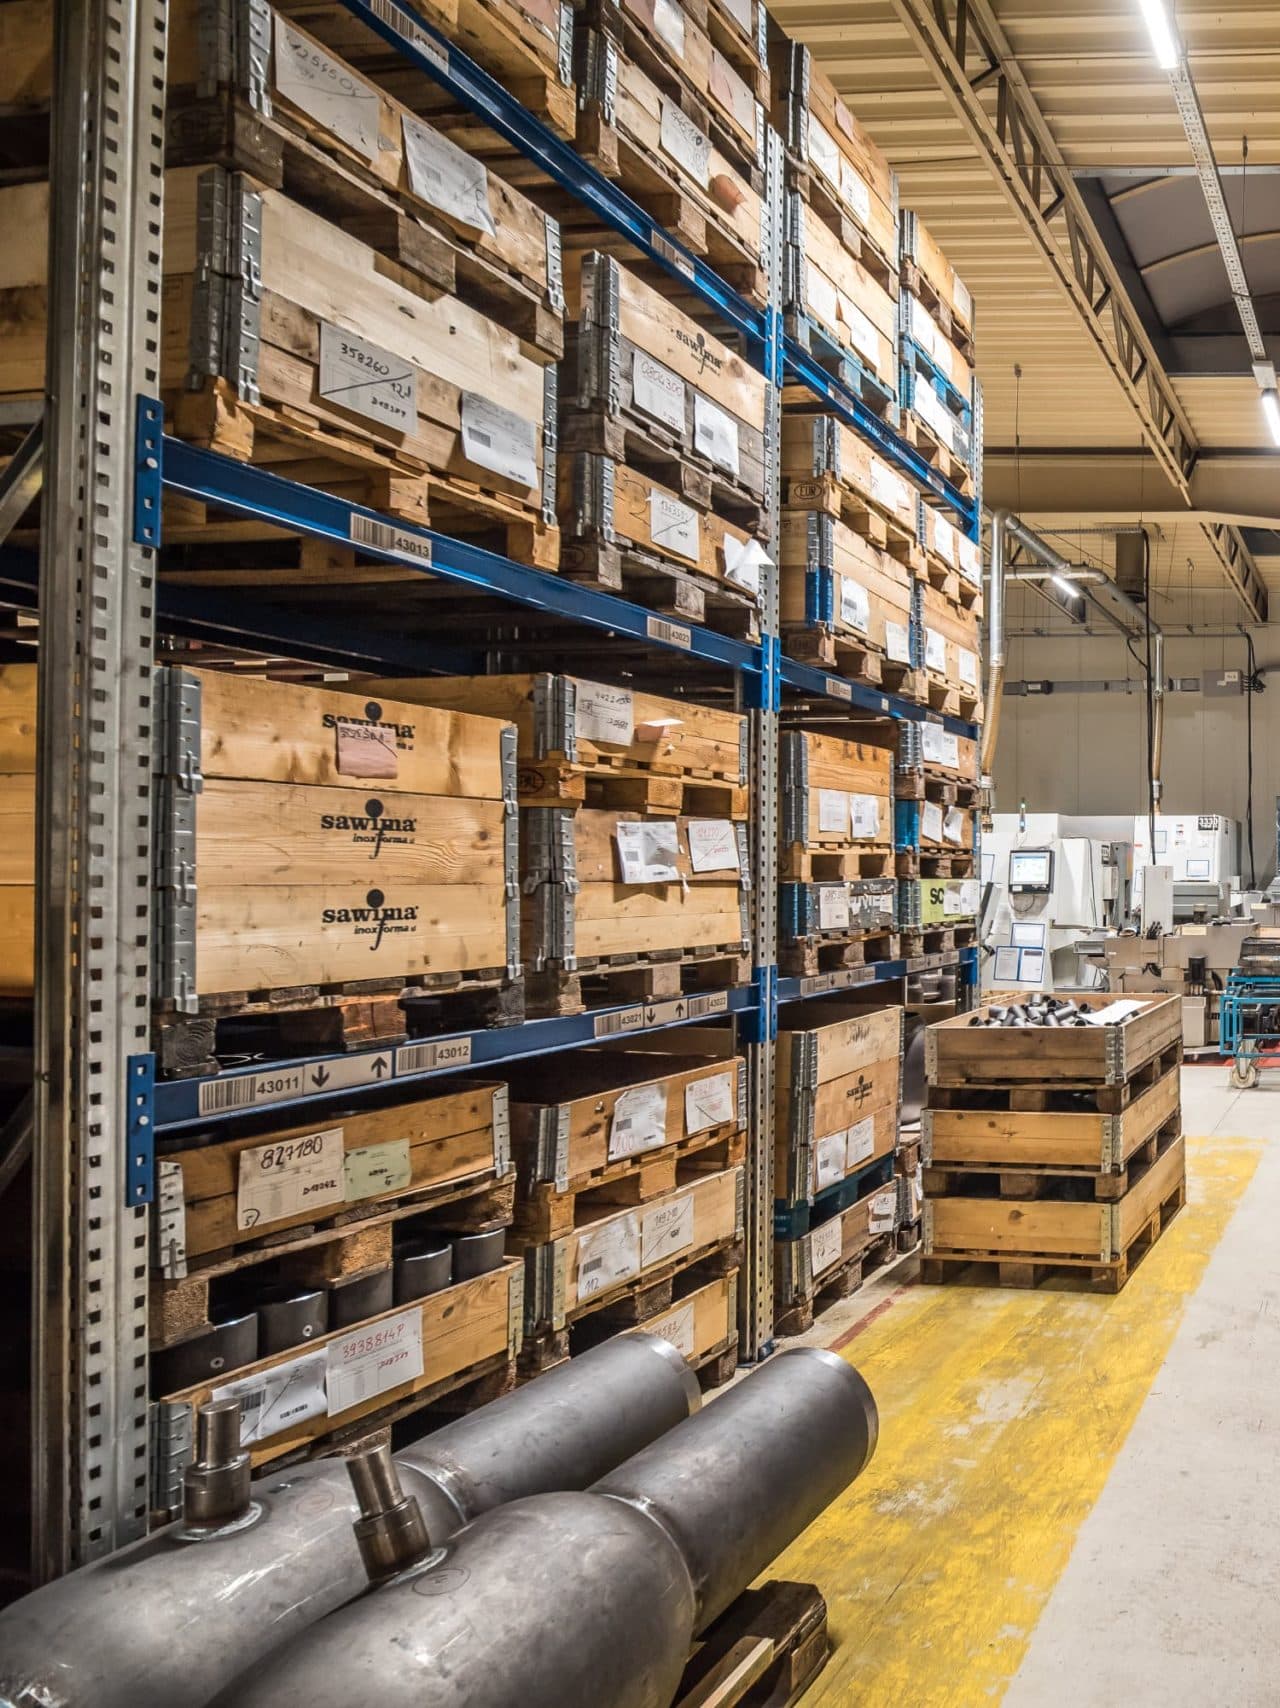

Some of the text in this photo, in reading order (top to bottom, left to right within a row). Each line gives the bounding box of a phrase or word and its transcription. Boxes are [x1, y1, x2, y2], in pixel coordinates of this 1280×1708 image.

[340, 342, 390, 376] 358260
[395, 537, 430, 558] 43013
[321, 799, 417, 832] sawima
[322, 889, 418, 924] sawima
[438, 1045, 469, 1060] 43012
[257, 1076, 300, 1095] 43011
[261, 1135, 323, 1169] 827180
